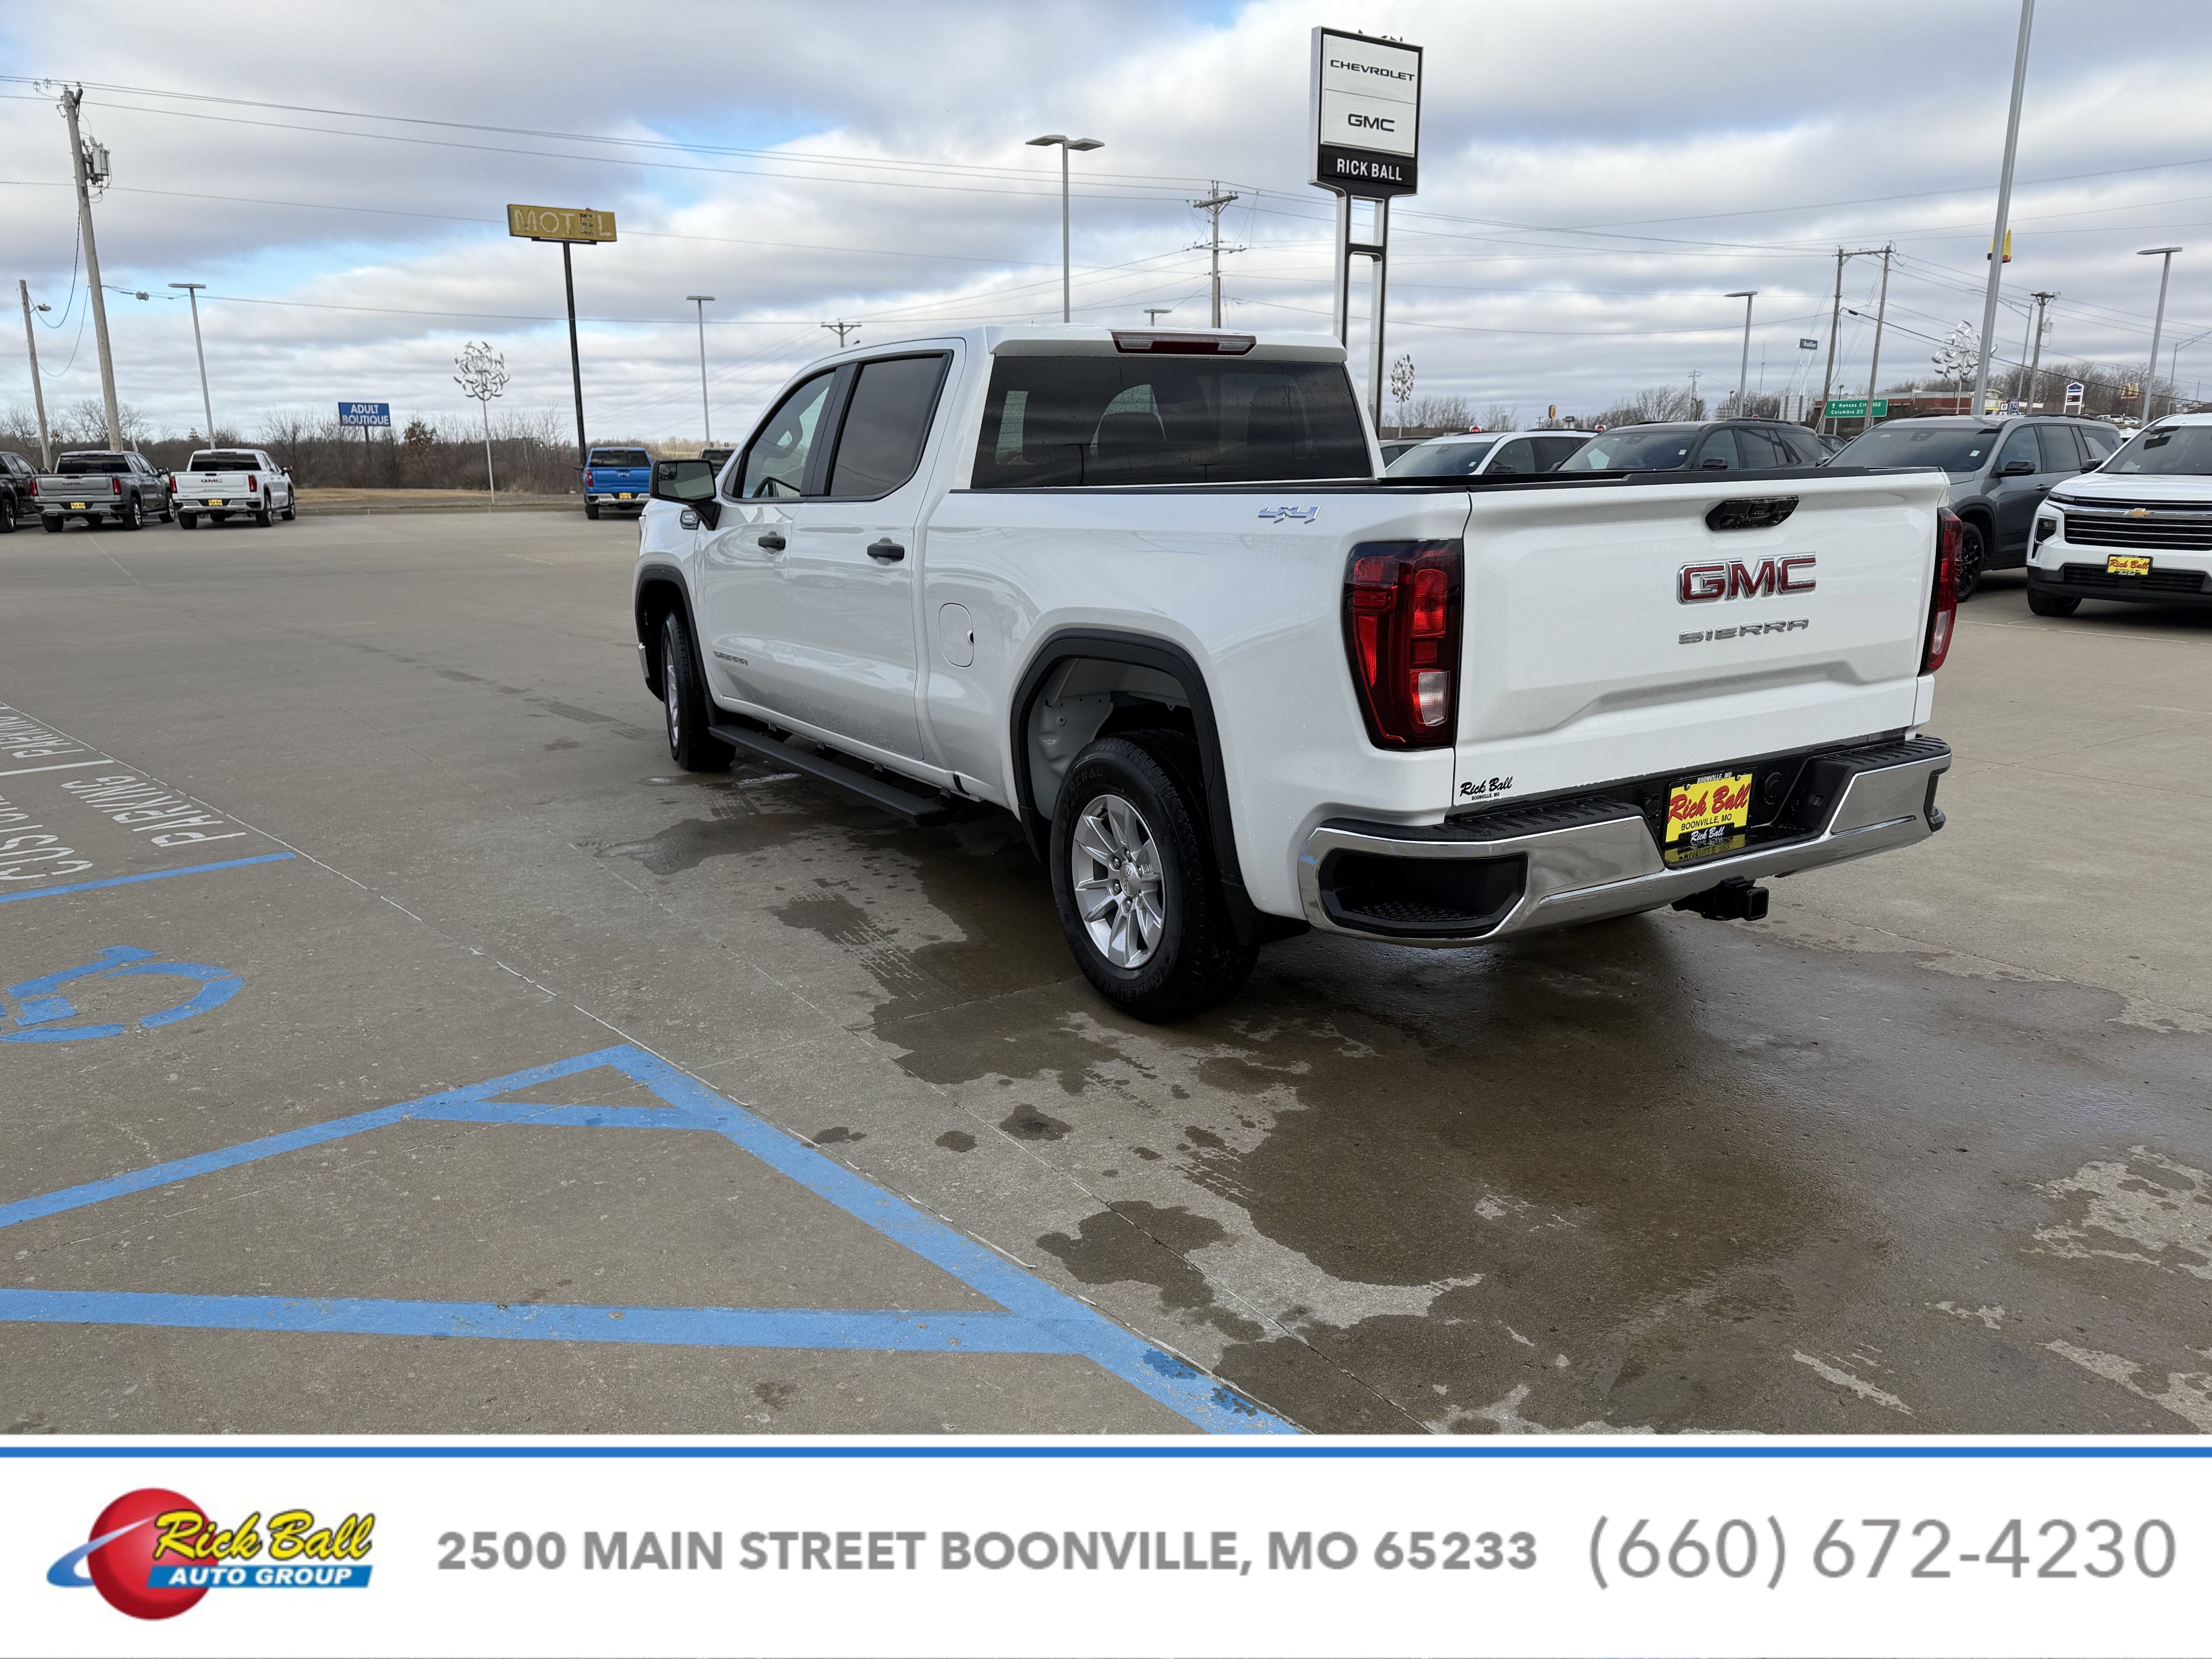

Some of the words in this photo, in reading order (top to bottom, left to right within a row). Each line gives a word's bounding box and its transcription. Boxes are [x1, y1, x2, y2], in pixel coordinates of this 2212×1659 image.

[1330, 59, 1415, 81] CHEVROLET
[1348, 113, 1395, 132] GMC
[1336, 158, 1368, 177] RICK
[1371, 163, 1402, 181] BALL
[515, 209, 612, 237] MOTEL
[351, 404, 379, 414] ADULT
[342, 415, 389, 425] BOUTIQUE
[2109, 559, 2129, 568] Rick
[1676, 552, 1817, 605] GMC
[1678, 618, 1809, 644] SIERRA
[1460, 780, 1487, 797] Rick
[1489, 776, 1513, 792] Ball
[61, 776, 247, 847] PARKING
[1668, 790, 1709, 824] Rick
[1711, 782, 1751, 814] Ball
[1681, 816, 1720, 831] BOONVILLE,
[1721, 813, 1732, 822] MO
[1690, 830, 1707, 843] Rick
[1709, 826, 1725, 838] Ball
